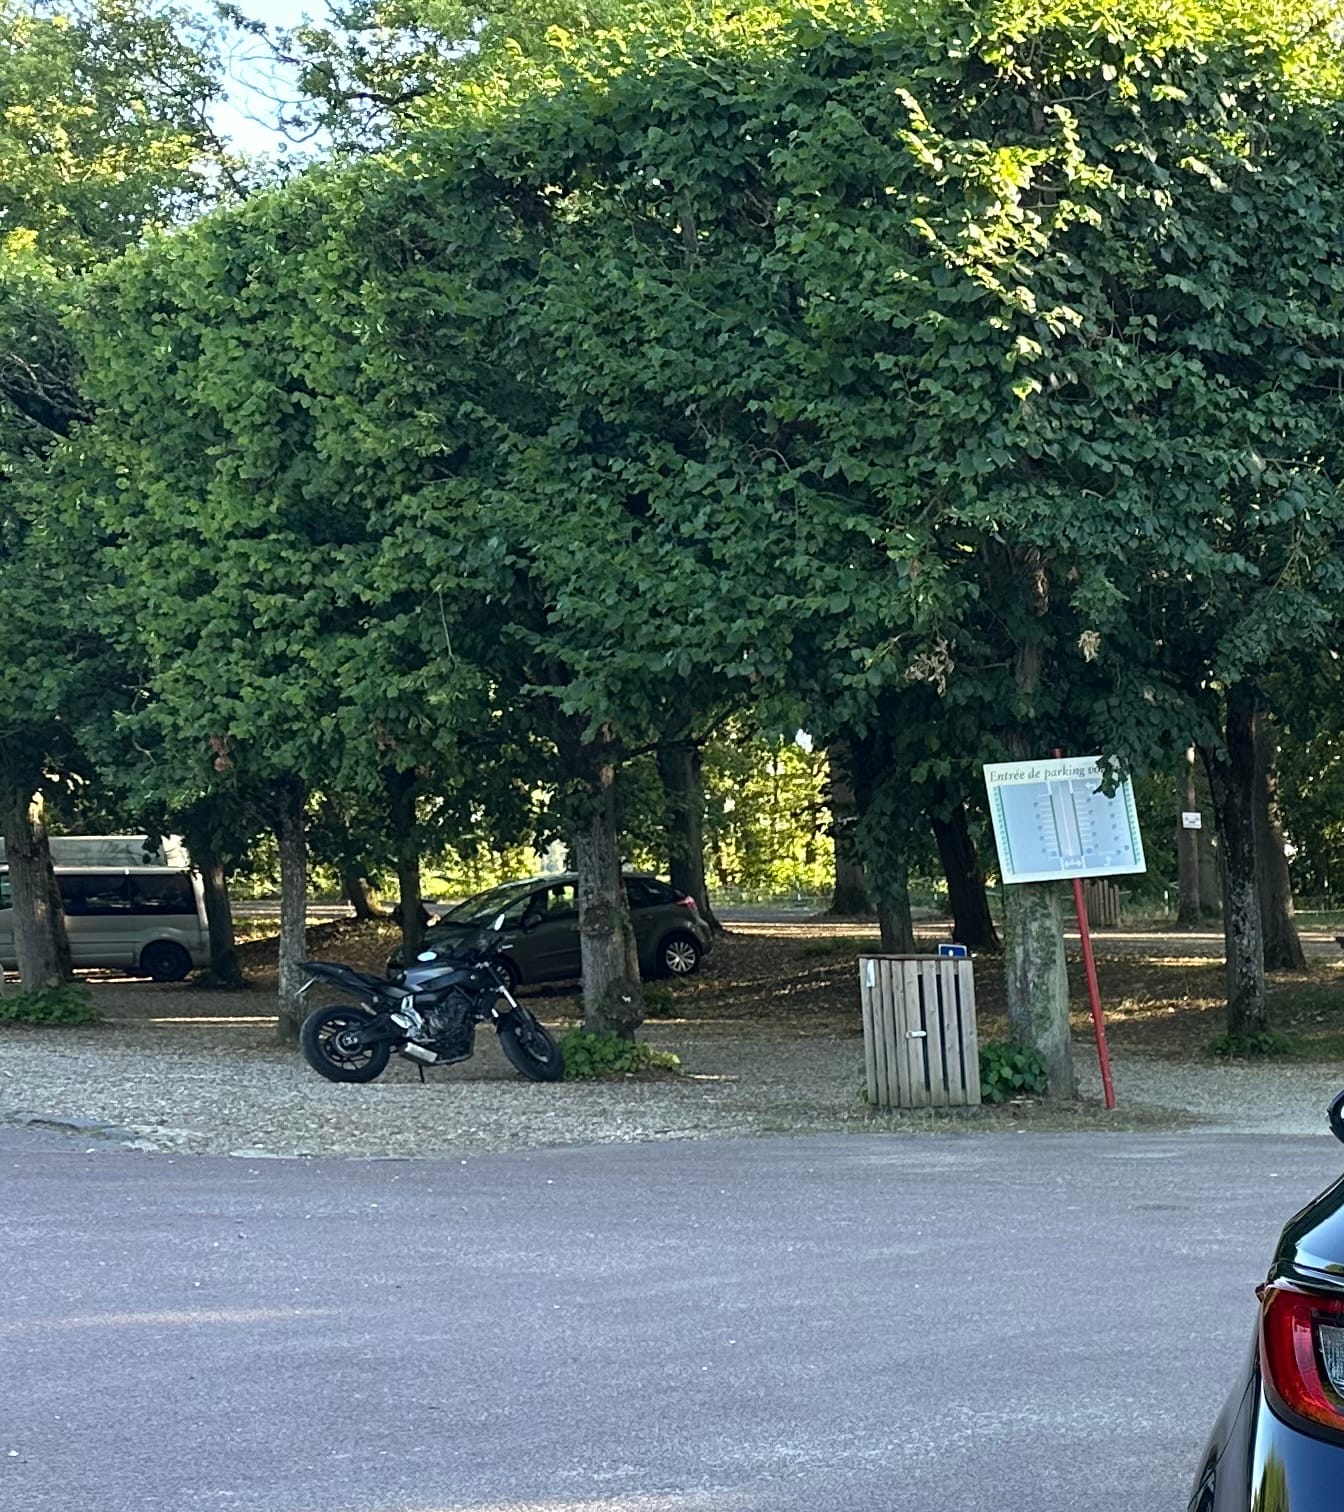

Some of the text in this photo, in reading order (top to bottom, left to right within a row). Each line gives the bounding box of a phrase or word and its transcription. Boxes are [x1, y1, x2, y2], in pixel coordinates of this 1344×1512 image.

[990, 768, 1025, 782] Entrée
[1028, 767, 1040, 779] de
[1044, 764, 1085, 780] parking
